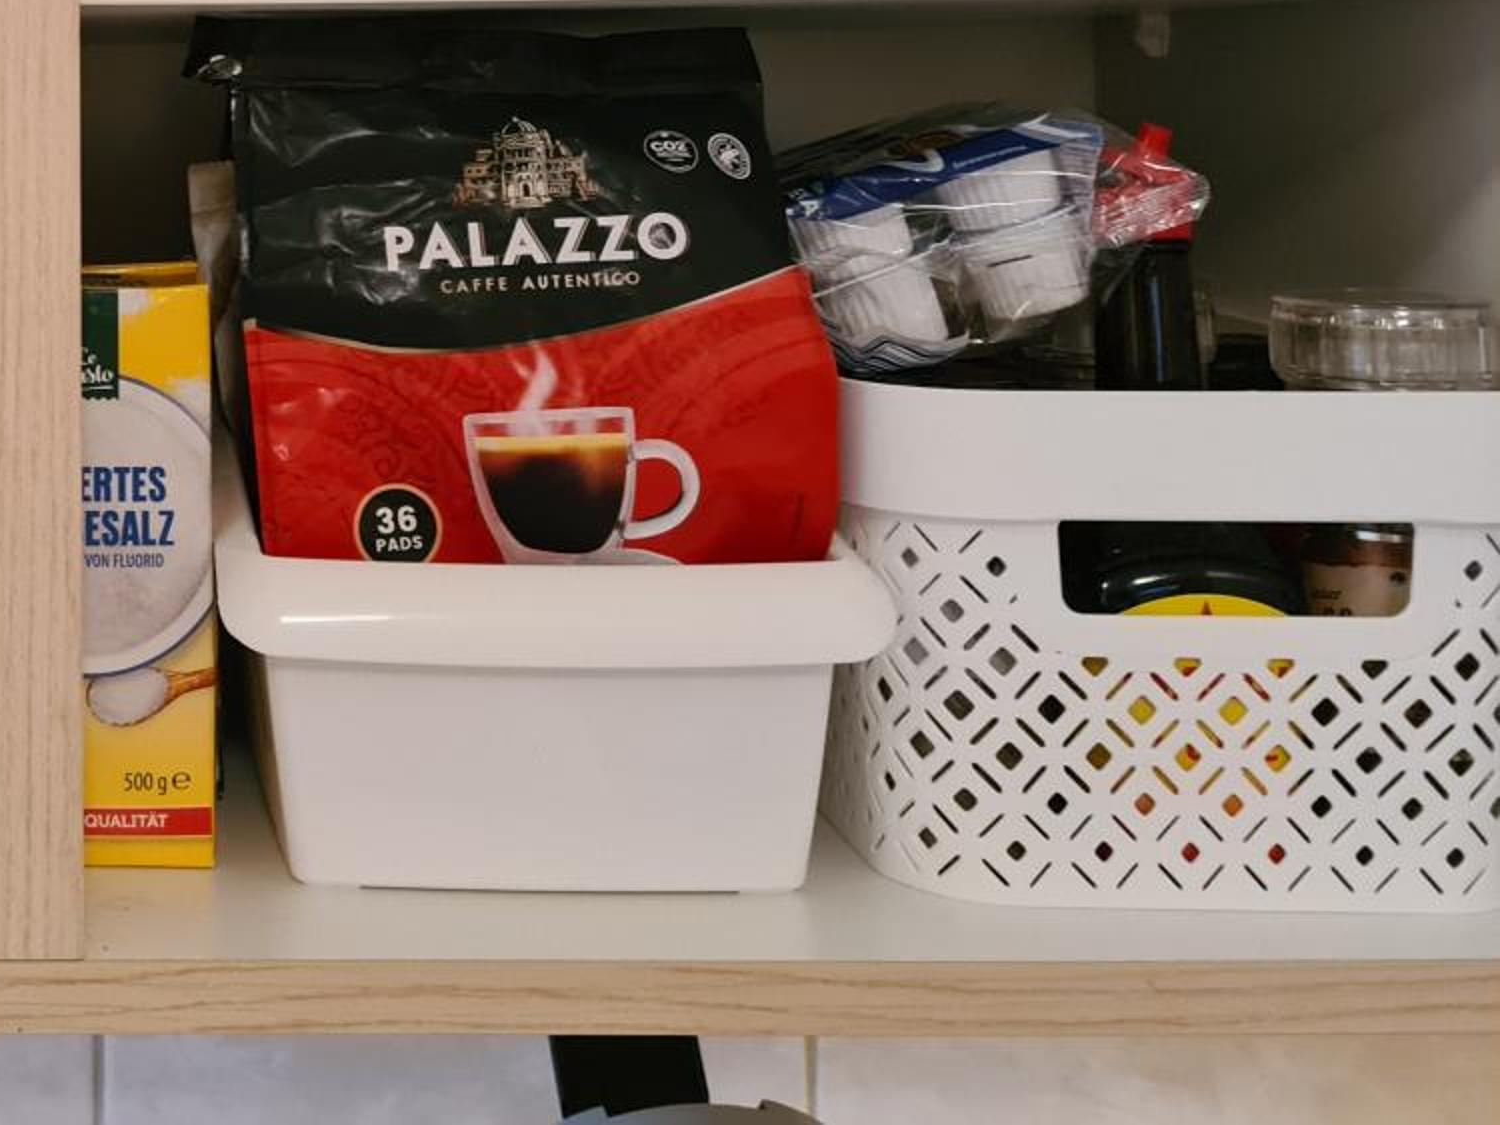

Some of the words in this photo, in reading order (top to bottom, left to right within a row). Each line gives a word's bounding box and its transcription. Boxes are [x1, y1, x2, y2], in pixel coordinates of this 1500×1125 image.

[383, 212, 688, 272] PALAZZO
[439, 277, 509, 295] CAFFE
[521, 271, 641, 292] AUTENTICO
[376, 505, 418, 534] 36
[375, 535, 424, 553] PADS
[83, 552, 110, 568] VON
[113, 552, 164, 568] FLUORID
[124, 772, 153, 791] 500
[157, 776, 167, 796] g
[84, 810, 168, 828] QUALITÄT
